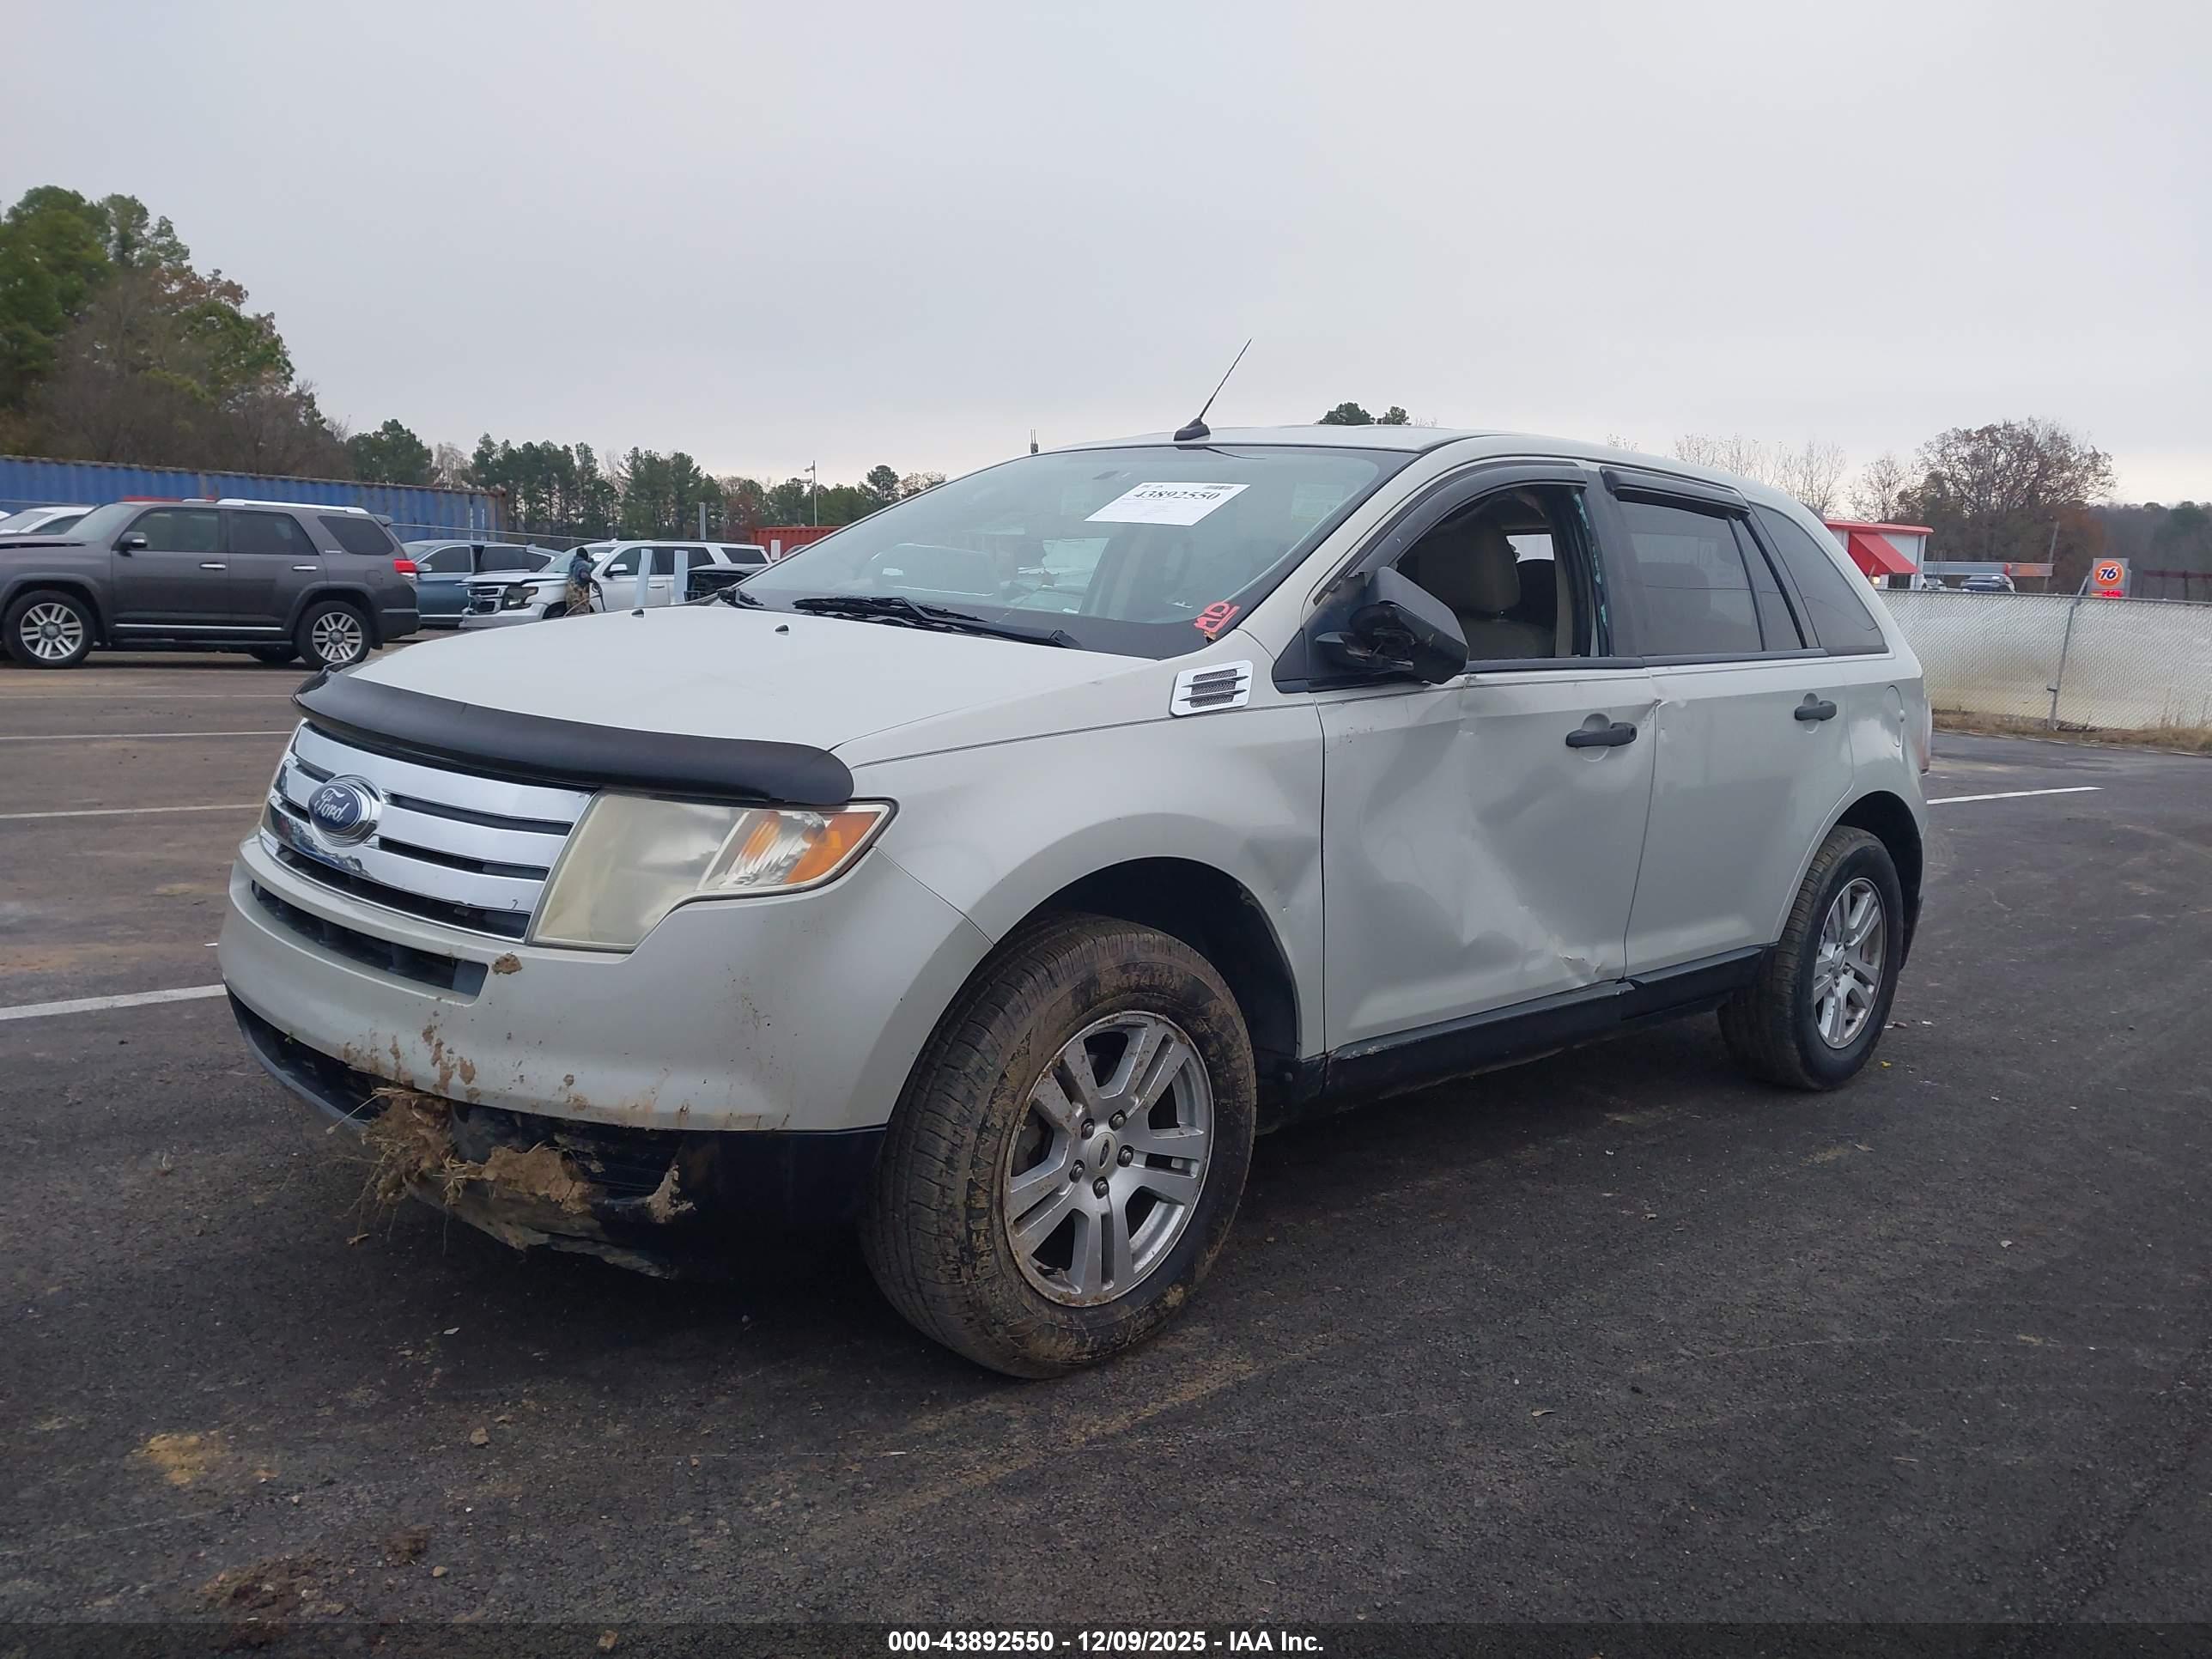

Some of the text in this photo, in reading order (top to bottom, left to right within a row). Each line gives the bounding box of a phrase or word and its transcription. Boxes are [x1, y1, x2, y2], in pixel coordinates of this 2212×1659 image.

[1133, 489, 1221, 501] 43892550
[2099, 567, 2118, 580] 76
[314, 787, 350, 822] Ford
